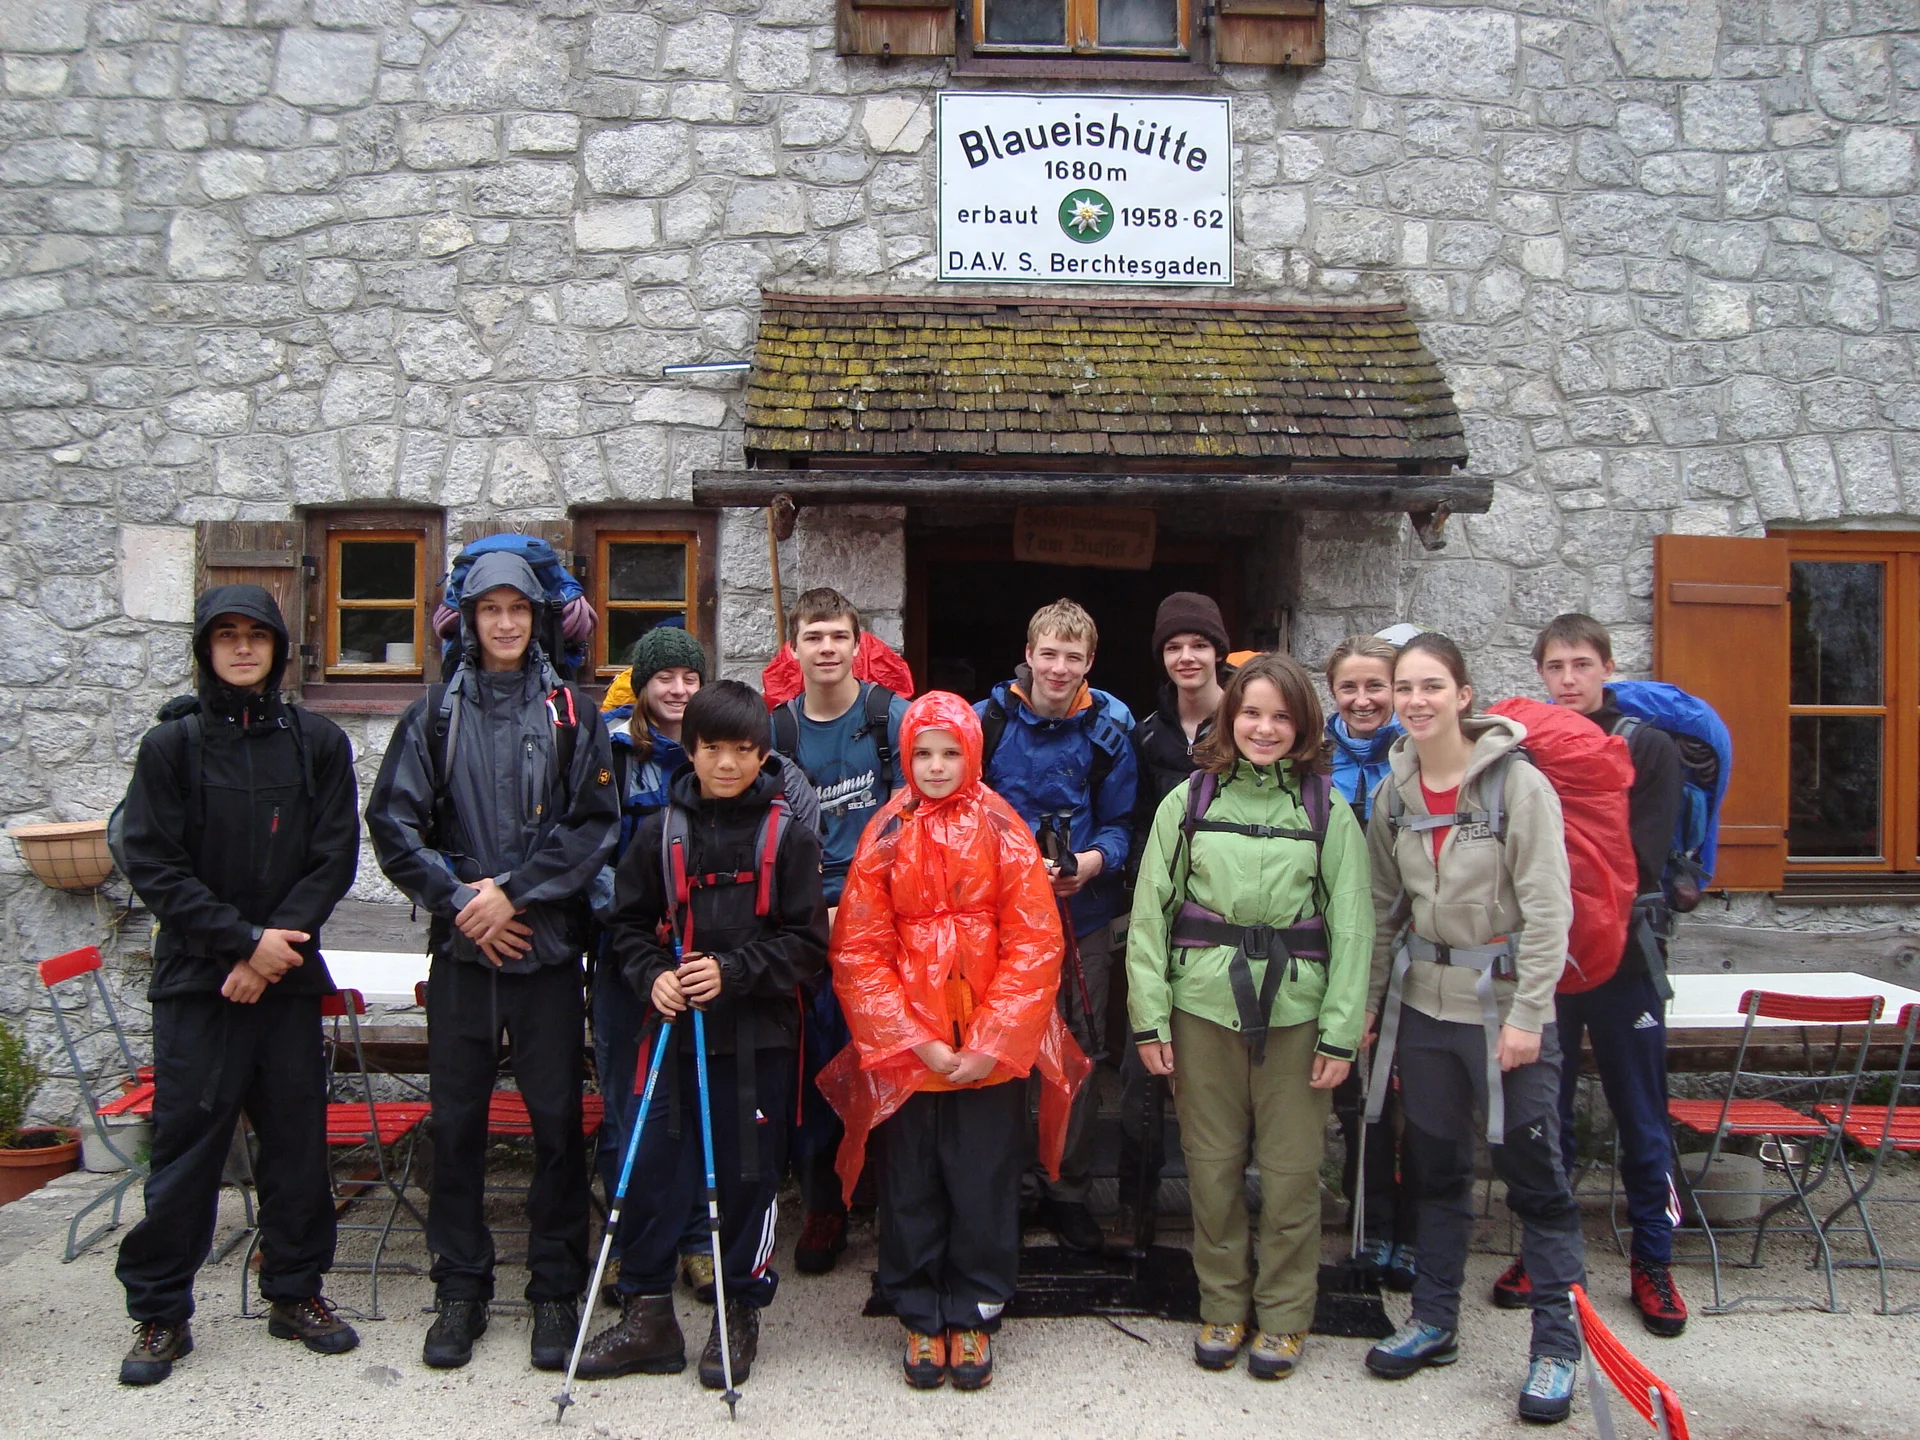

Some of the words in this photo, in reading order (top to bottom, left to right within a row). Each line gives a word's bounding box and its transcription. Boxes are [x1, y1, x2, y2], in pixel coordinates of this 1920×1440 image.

[959, 113, 1206, 171] Blaueishütte
[958, 205, 1037, 224] erbaut
[950, 252, 1006, 270] D.A.V.
[1019, 253, 1036, 271] S.
[1051, 253, 1220, 279] Berchtesgaden
